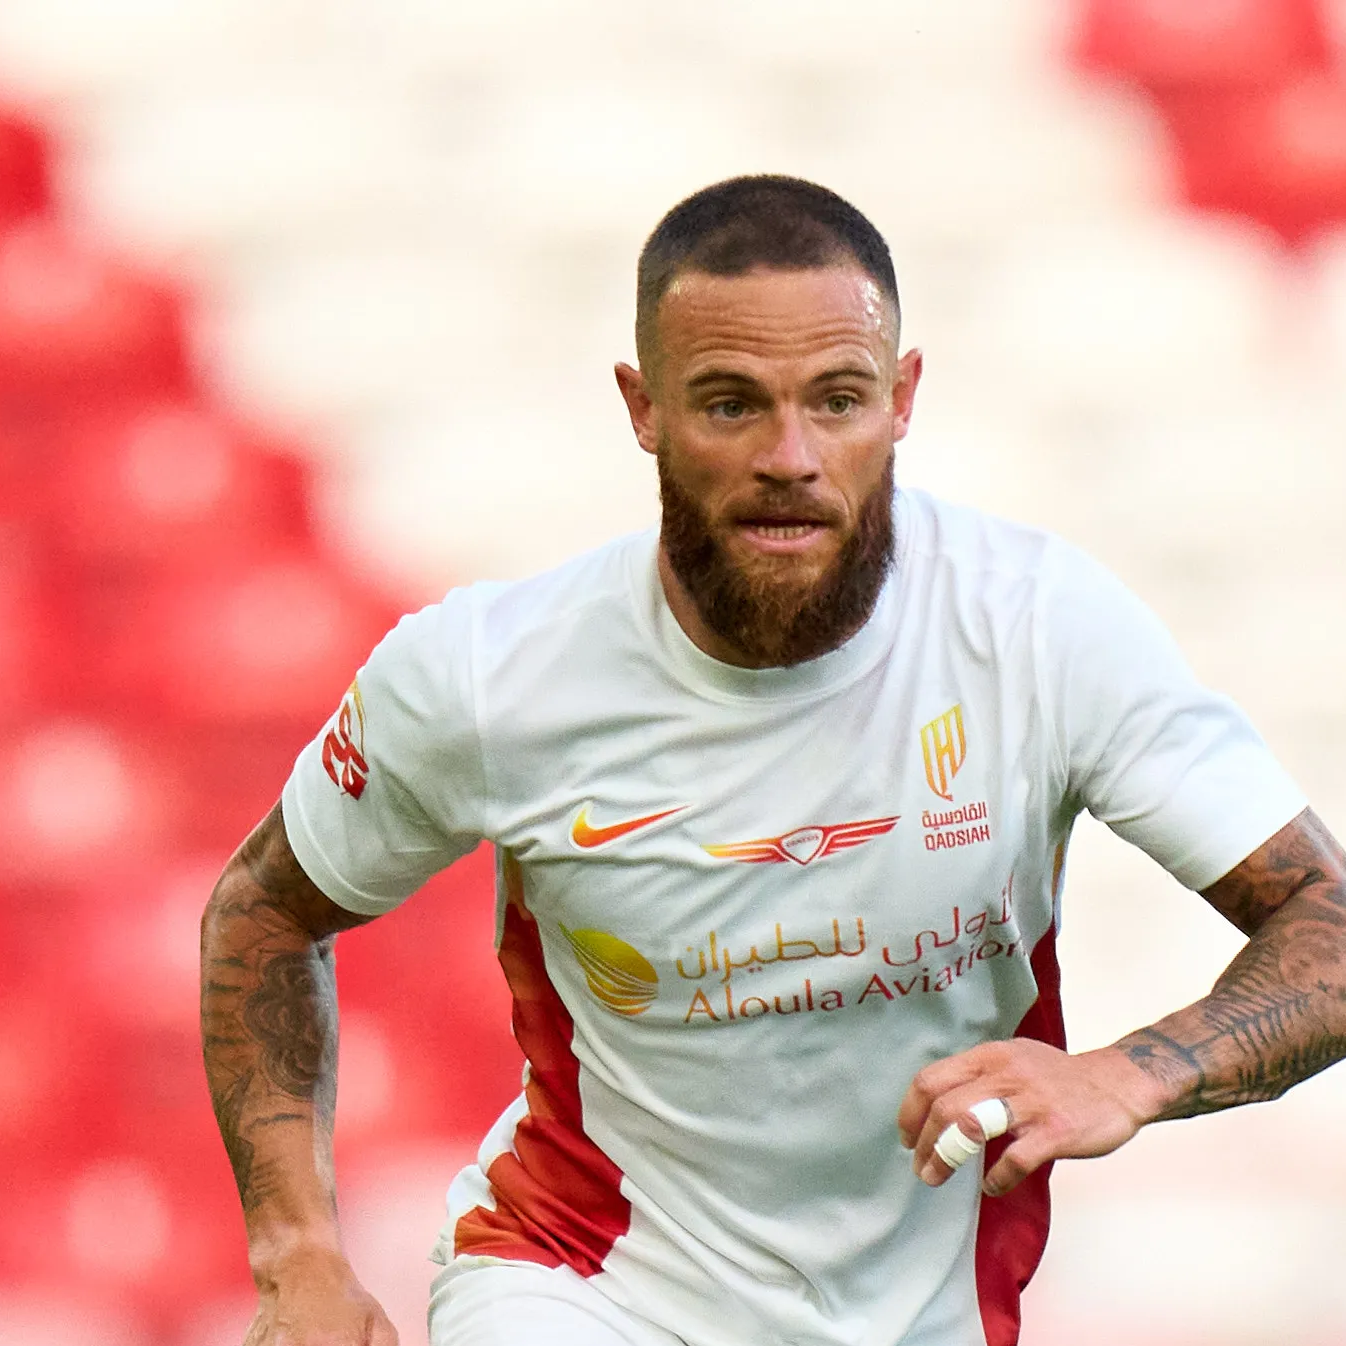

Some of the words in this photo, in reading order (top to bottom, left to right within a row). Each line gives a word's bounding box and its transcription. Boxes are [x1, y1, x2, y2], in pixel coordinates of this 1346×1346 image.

[924, 824, 991, 852] QADSIAH
[676, 916, 867, 984] للطيران
[683, 978, 845, 1025] Aloula
